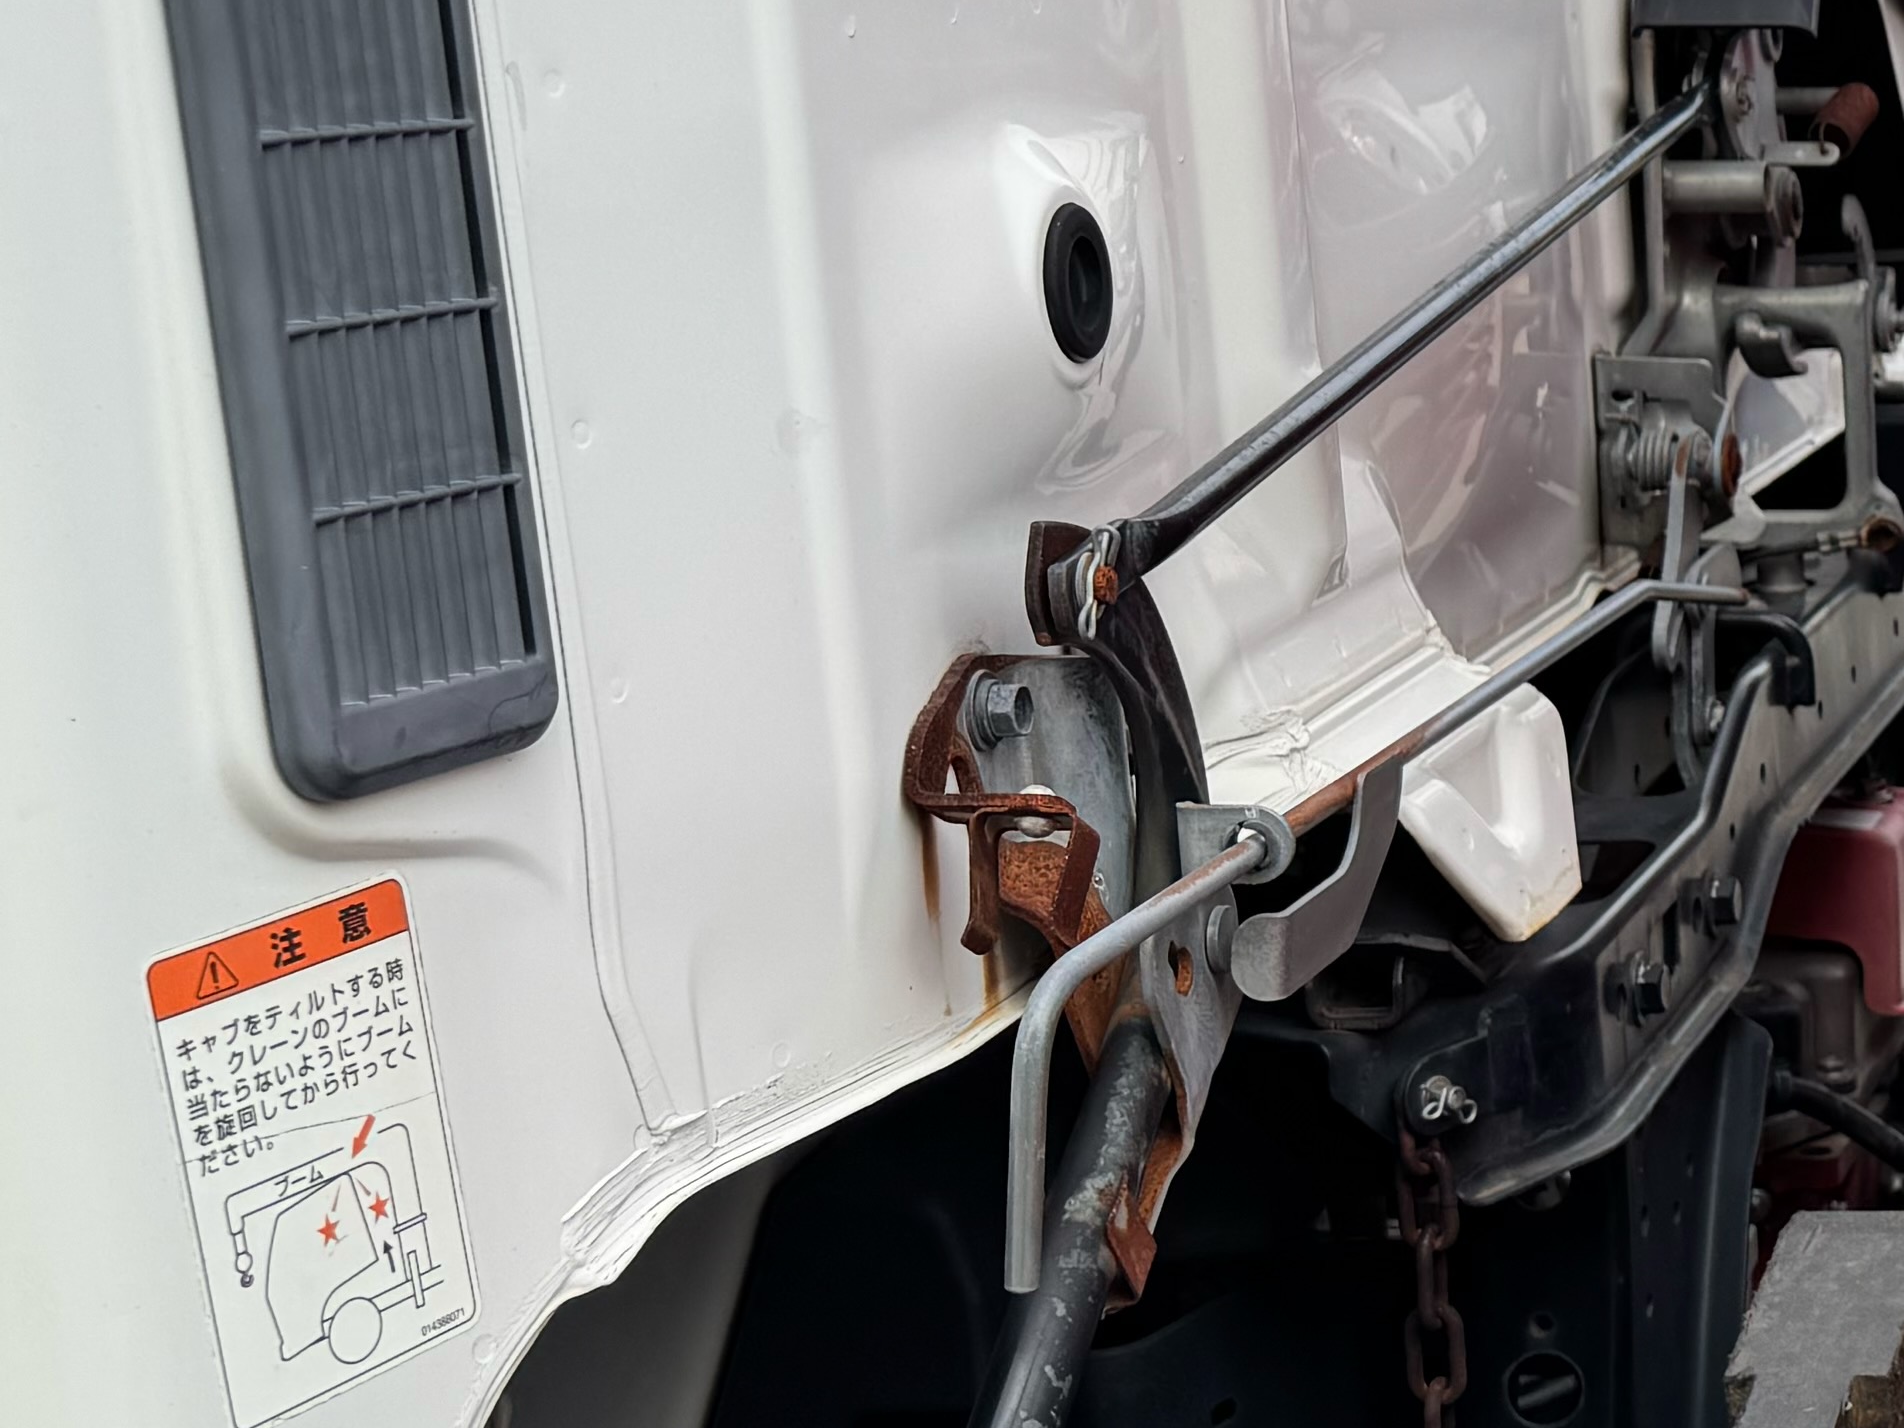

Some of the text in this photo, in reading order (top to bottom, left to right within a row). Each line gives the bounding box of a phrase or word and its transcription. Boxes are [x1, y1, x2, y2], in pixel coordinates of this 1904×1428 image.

[270, 902, 372, 969] 注意
[176, 958, 403, 1061] キャブをティルトする時
[182, 988, 408, 1091] は、クレーンのブームに
[187, 1015, 413, 1121] 当たらないようにブーム
[193, 1040, 416, 1147] を旋回してから行ってく
[199, 1138, 274, 1177] ださい。
[274, 1165, 324, 1194] ブーム
